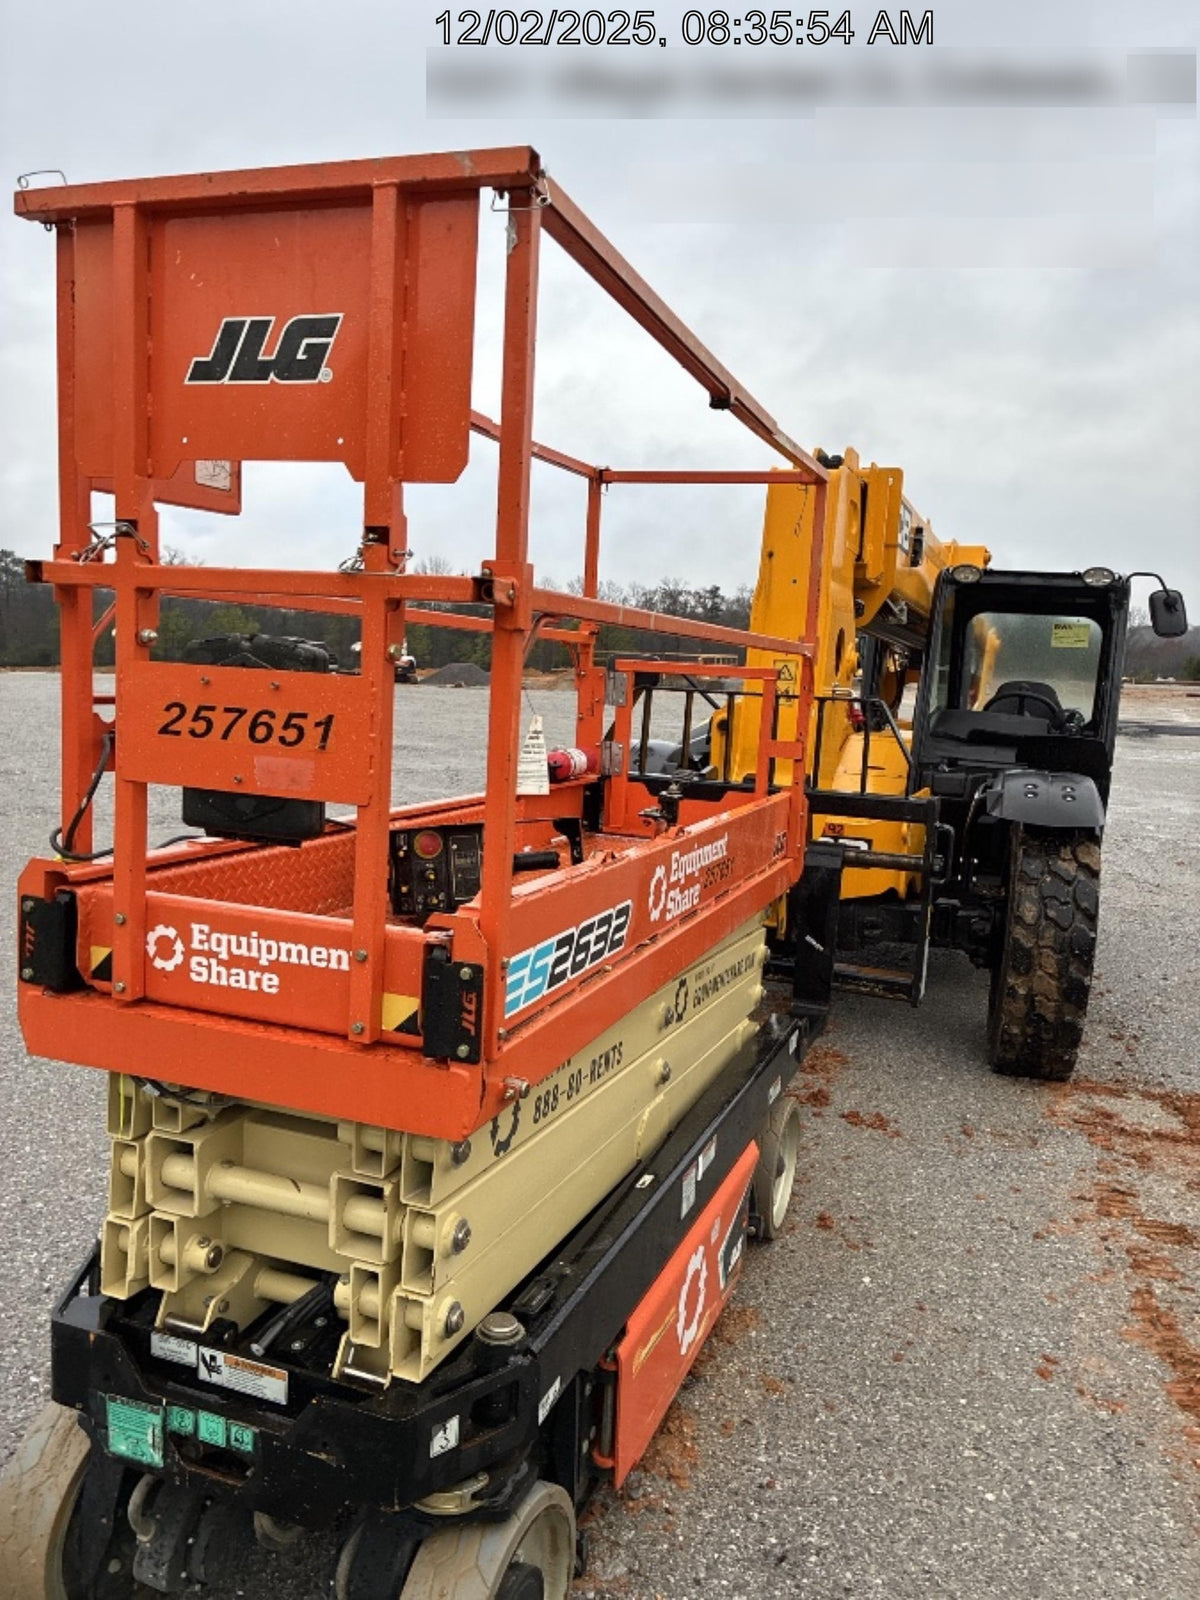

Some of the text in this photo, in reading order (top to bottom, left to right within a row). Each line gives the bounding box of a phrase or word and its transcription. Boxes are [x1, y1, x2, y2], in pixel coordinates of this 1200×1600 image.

[158, 702, 335, 751] 257651
[670, 832, 728, 884] Equipment
[666, 883, 701, 921] Share
[190, 922, 352, 971] Equipmen
[505, 900, 631, 1018] ES2632
[189, 955, 280, 994] Share
[462, 990, 477, 1036] JLG
[533, 1041, 623, 1124] 888-80-RENTS
